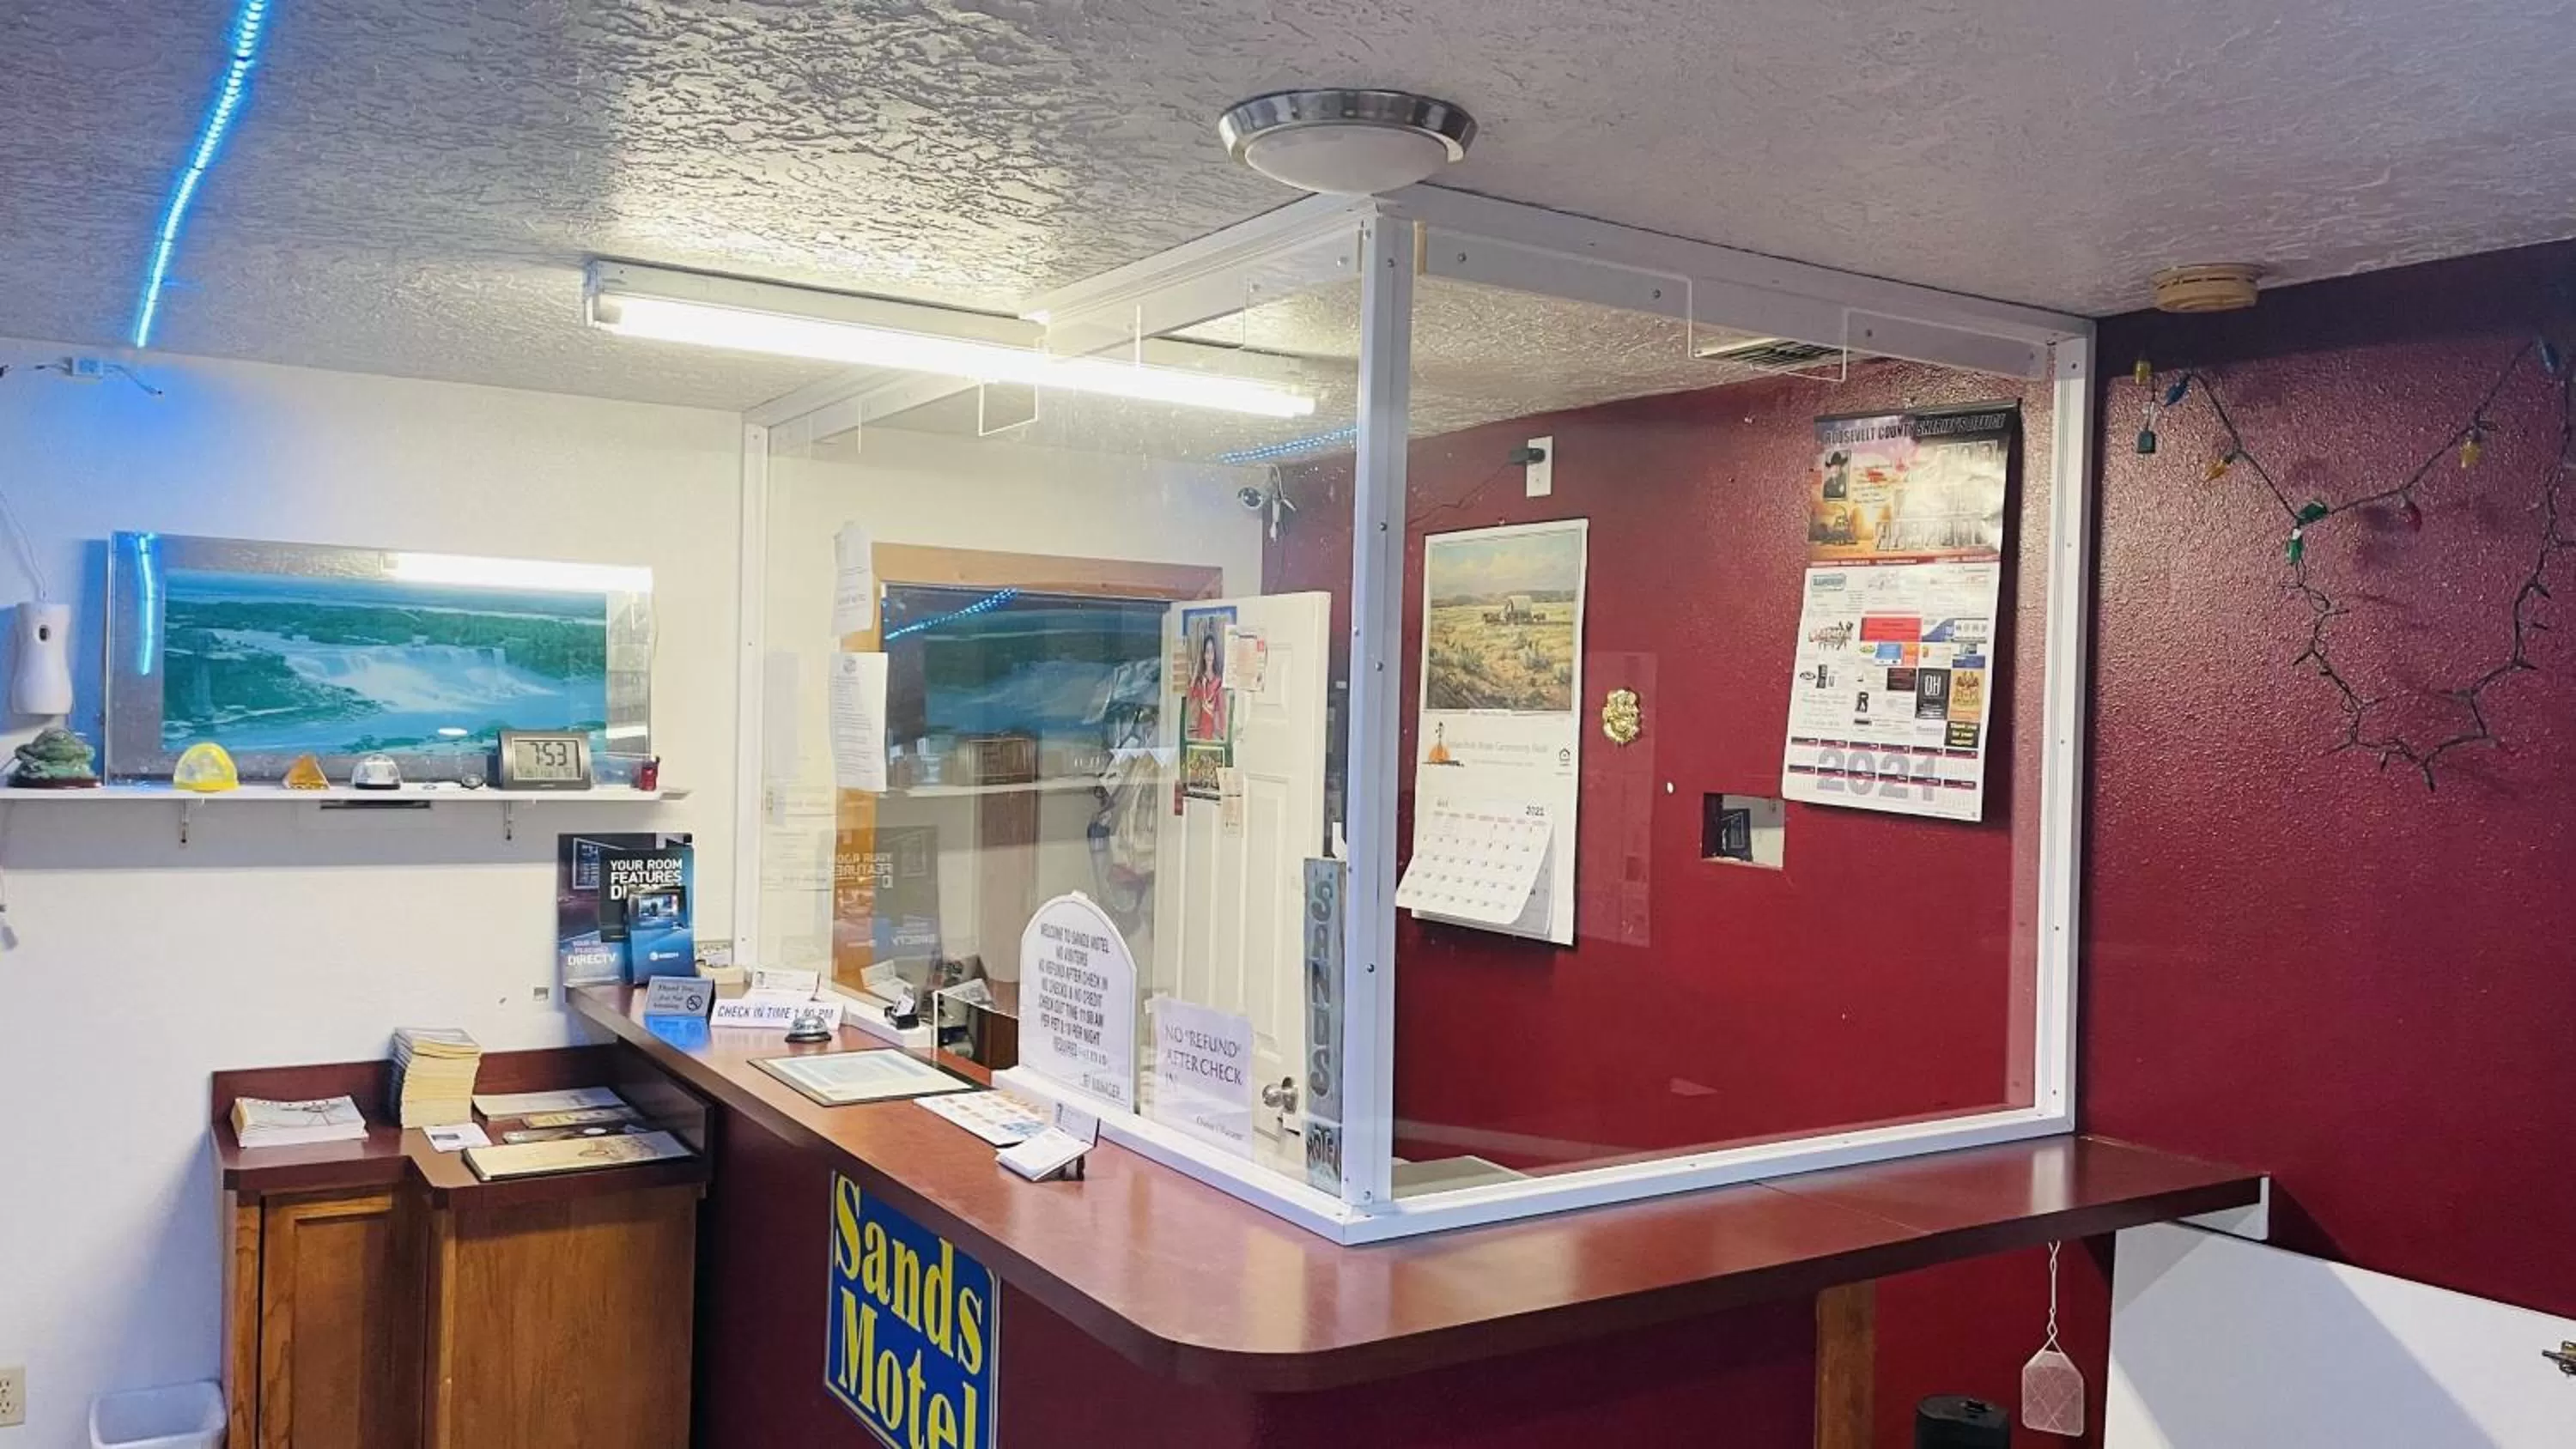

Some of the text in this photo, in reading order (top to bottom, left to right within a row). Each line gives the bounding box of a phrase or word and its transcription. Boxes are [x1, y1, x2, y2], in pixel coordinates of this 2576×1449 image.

[1826, 427, 1875, 445] ROOSEVELT
[1878, 423, 1917, 440] COUNTY
[1816, 748, 1936, 802] 2021
[611, 858, 683, 871] YOUR ROOM
[611, 870, 683, 884] FEATURES
[568, 952, 616, 966] DIRECTV
[717, 1005, 750, 1018] CHECK
[753, 1006, 764, 1018] IN
[767, 1007, 792, 1019] TIME
[1165, 1024, 1183, 1044] NO
[1167, 1048, 1243, 1086] AFTER CHECK
[835, 1174, 983, 1375] Sands
[838, 1286, 977, 1449] Motel
